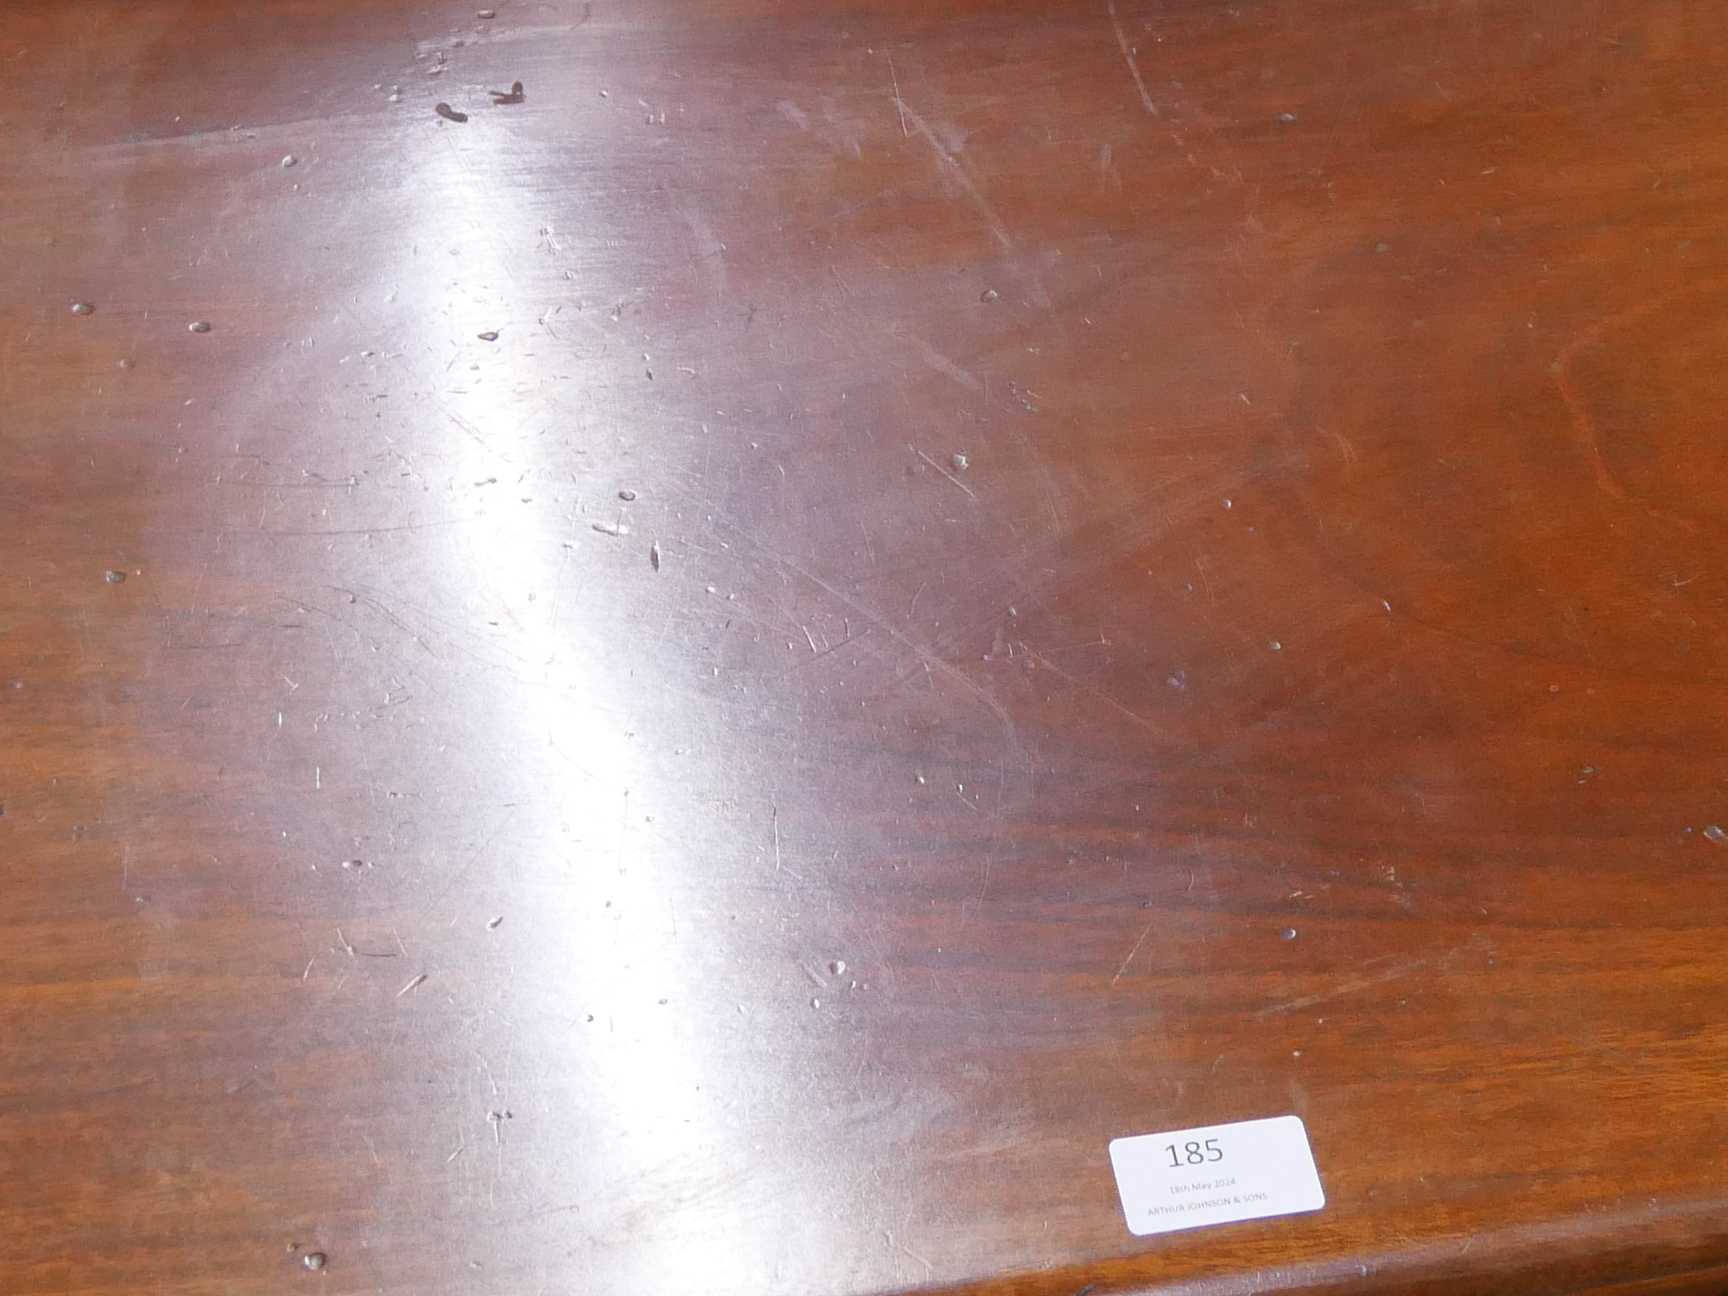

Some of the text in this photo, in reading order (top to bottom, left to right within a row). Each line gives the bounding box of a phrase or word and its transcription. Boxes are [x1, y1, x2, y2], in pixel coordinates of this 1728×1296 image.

[1164, 1138, 1224, 1168] 185
[1169, 1178, 1236, 1194] 18th May 2024
[1147, 1192, 1268, 1216] ARTHUR JOHNSON & SONS
